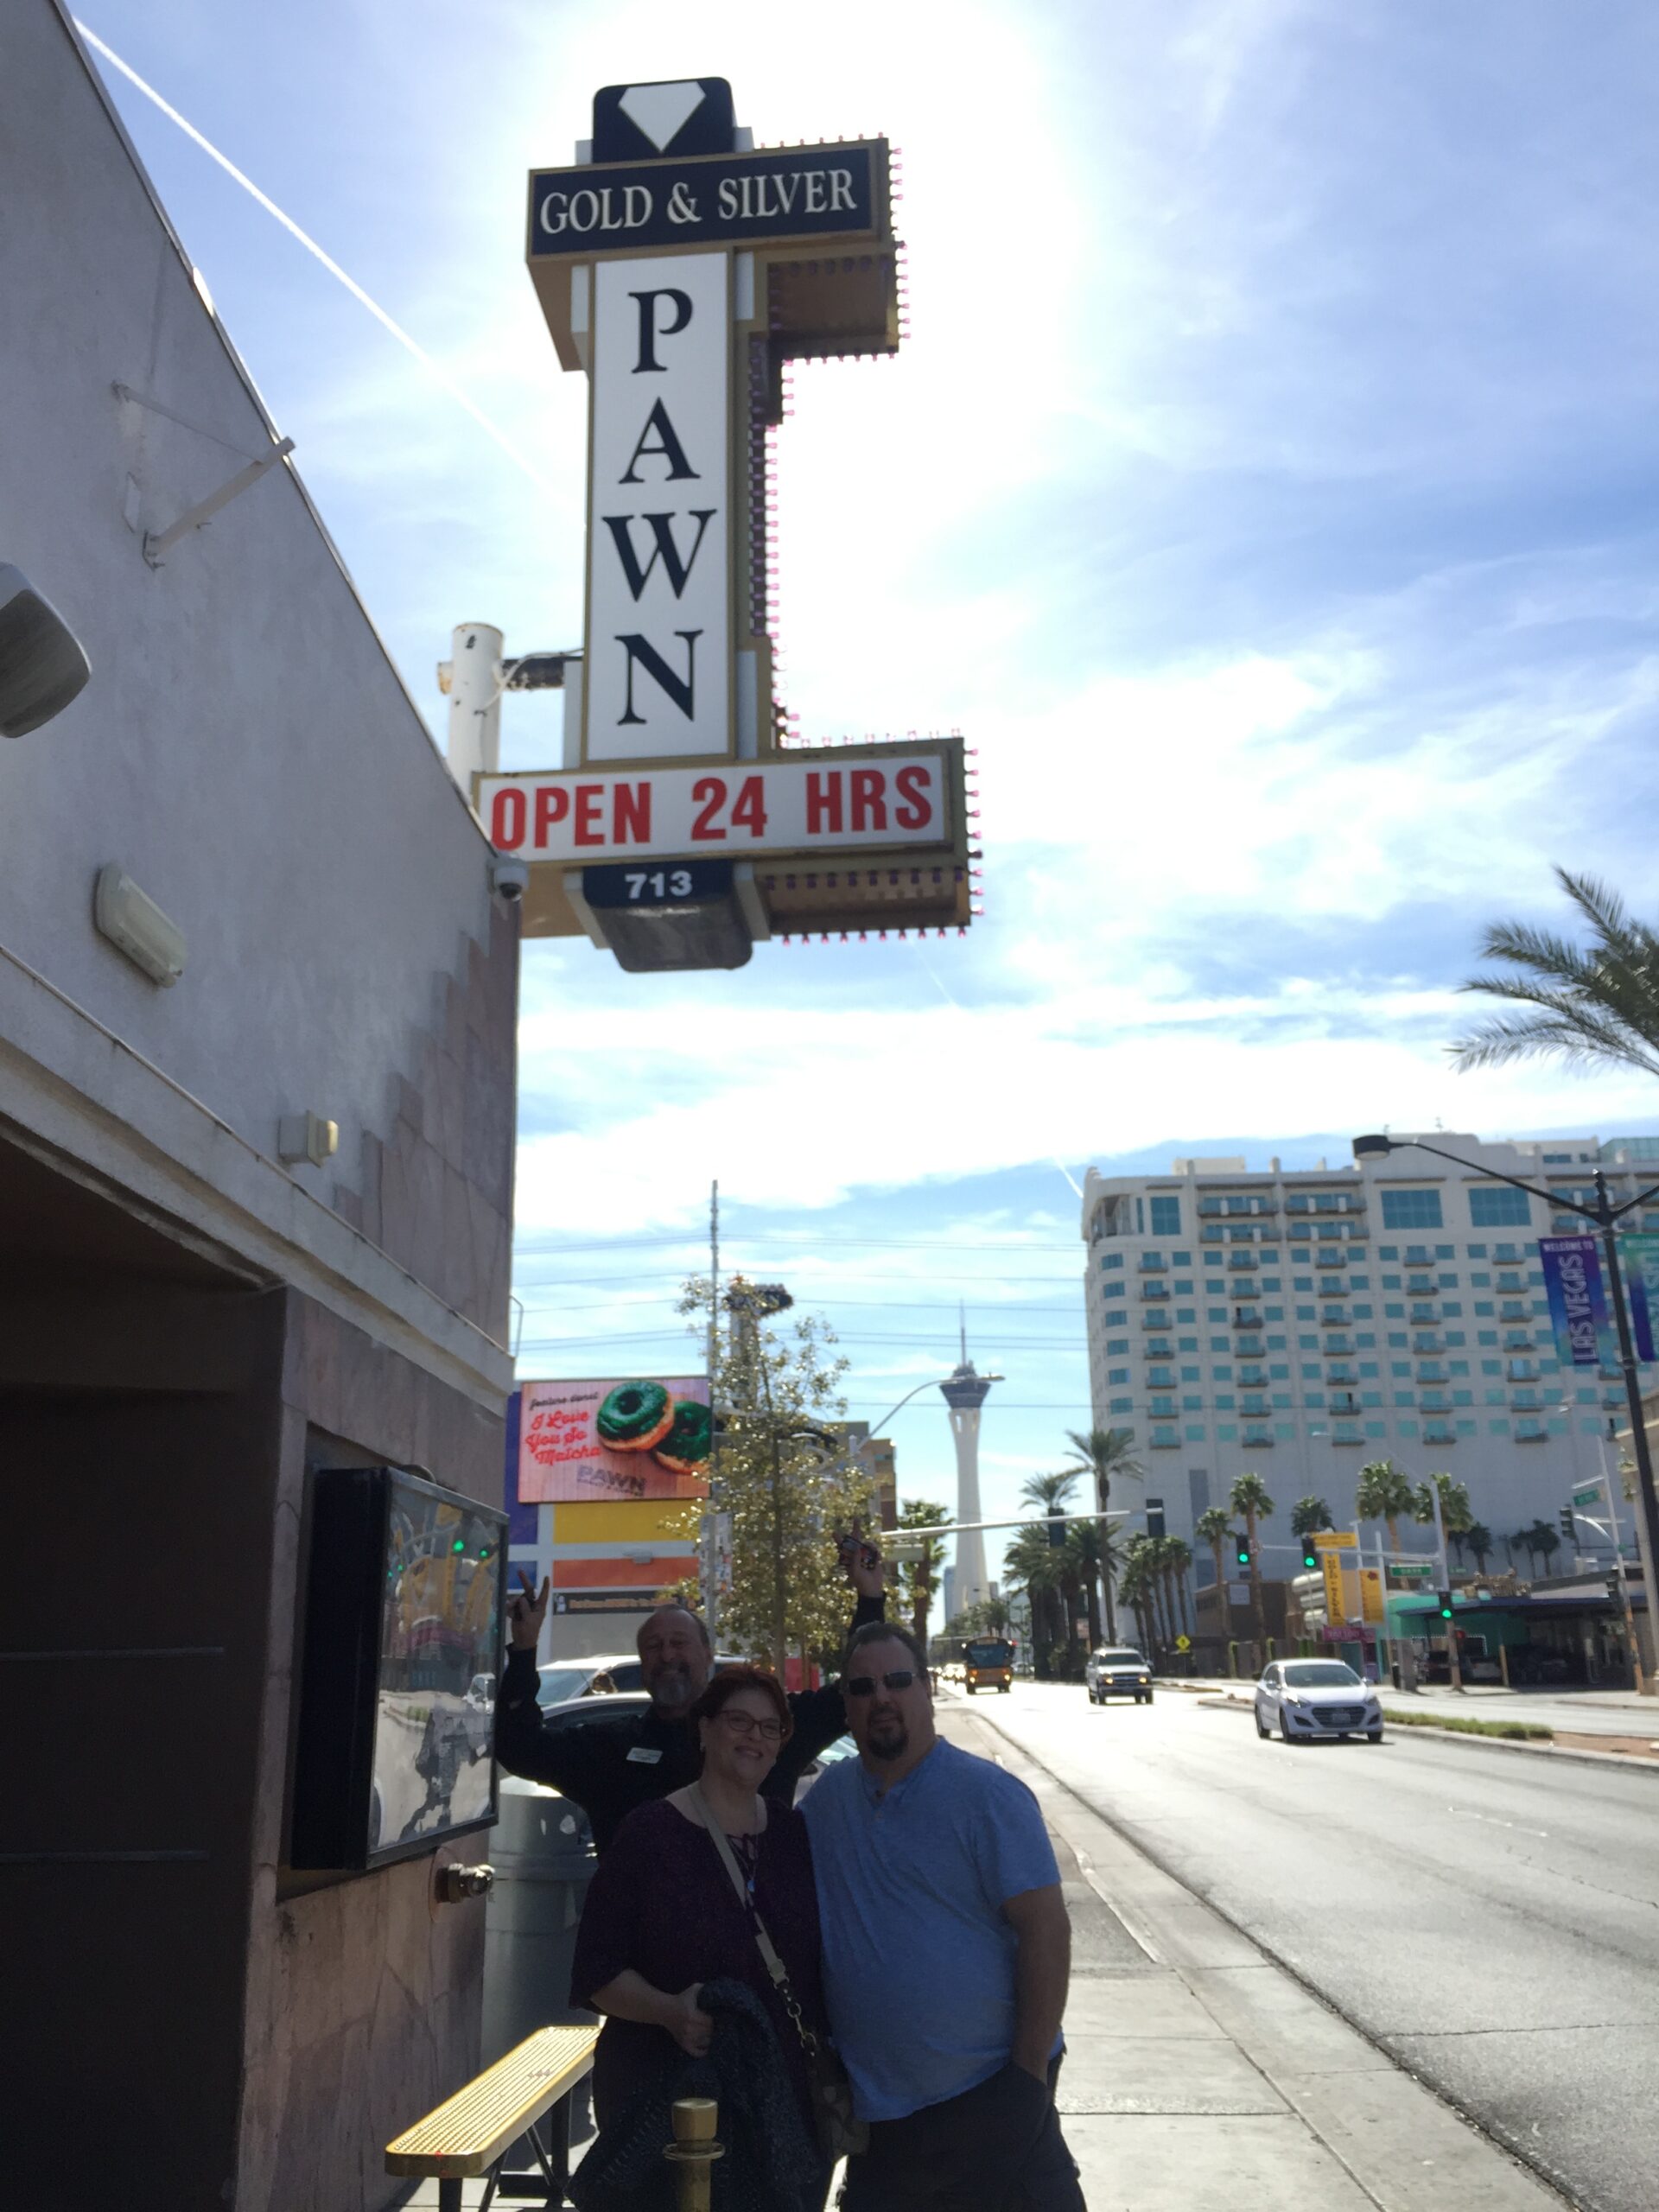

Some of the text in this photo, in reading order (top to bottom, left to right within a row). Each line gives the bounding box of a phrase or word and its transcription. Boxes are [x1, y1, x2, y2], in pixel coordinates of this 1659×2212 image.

[540, 168, 857, 234] GOLD & SILVER
[601, 288, 718, 727] PAWN
[491, 766, 933, 851] OPEN 24 HRS
[625, 871, 693, 899] 713
[1543, 1241, 1583, 1252] WELCOME
[1558, 1254, 1598, 1361] LAS VEGAS
[547, 1410, 589, 1429] Love
[525, 1433, 560, 1453] You
[576, 1465, 646, 1496] PAWN
